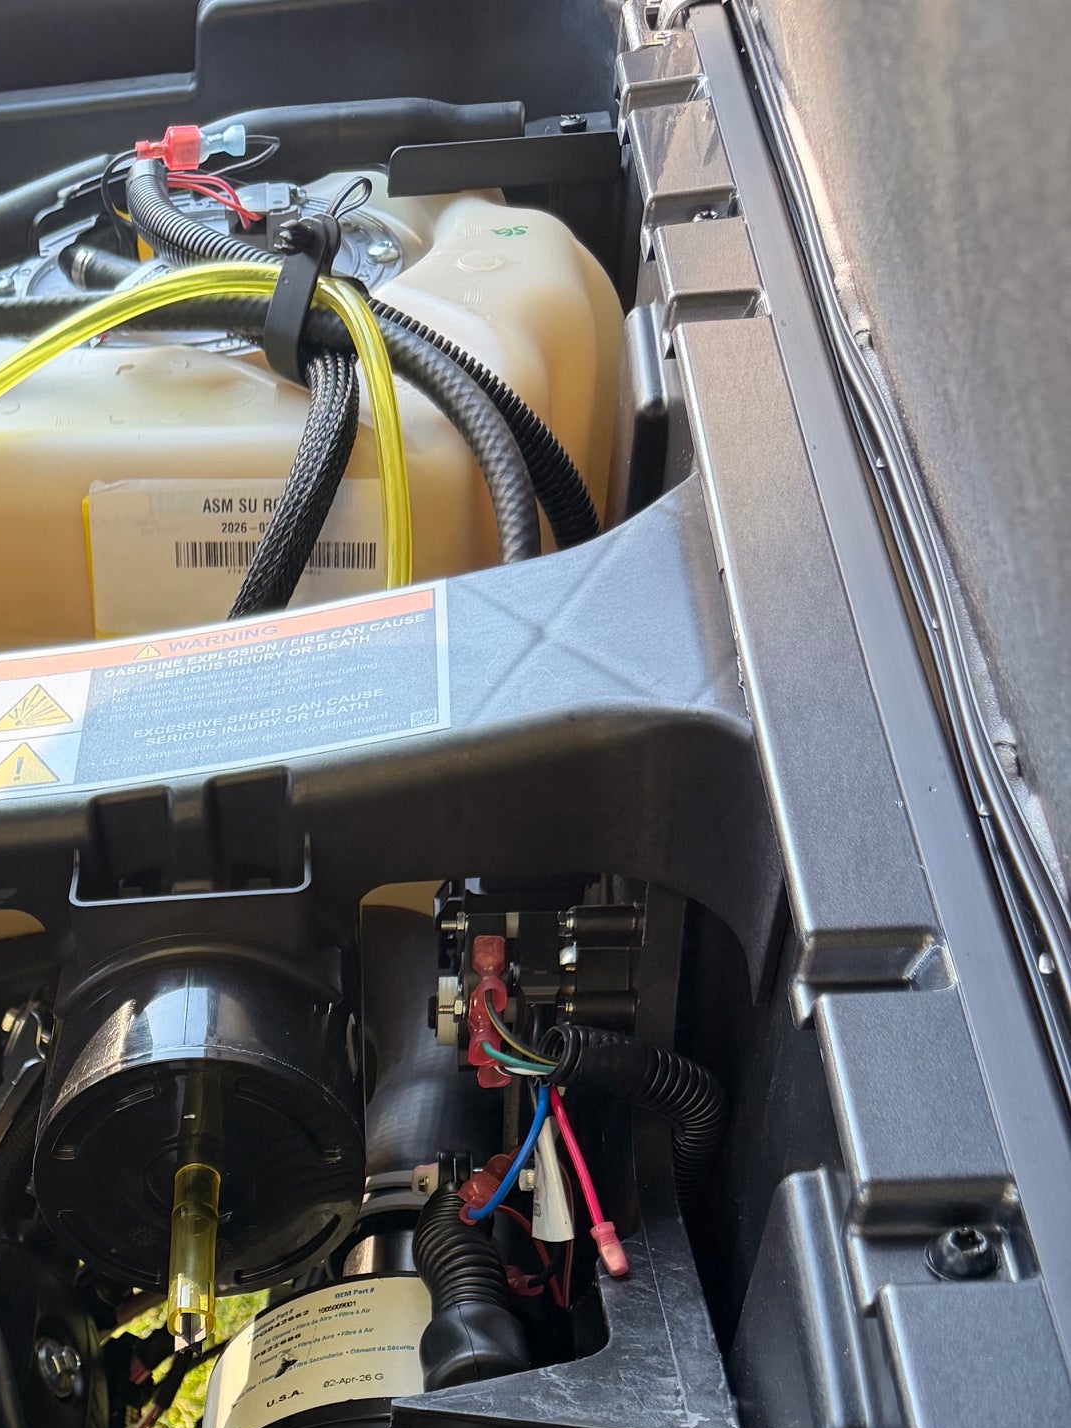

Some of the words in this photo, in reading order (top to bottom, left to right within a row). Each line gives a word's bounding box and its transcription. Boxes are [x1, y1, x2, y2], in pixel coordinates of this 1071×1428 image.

[203, 498, 232, 513] ASM
[239, 498, 257, 513] SU
[104, 658, 182, 677] GASOLINE
[187, 642, 276, 665] EXPLOSION
[281, 640, 286, 648] /
[290, 632, 325, 647] FIRE
[330, 625, 364, 638] CAN
[369, 613, 424, 631] CAUSE
[168, 625, 277, 652] WARNING
[154, 661, 222, 679] SERIOUS
[227, 650, 284, 667] INJURY
[288, 644, 312, 656] OR
[317, 634, 370, 651] DEATH
[133, 717, 222, 738] EXCESSIVE
[227, 707, 282, 723] SPEED
[286, 700, 321, 713] CAN
[326, 687, 383, 705] CAUSE
[145, 727, 216, 746] SERIOUS
[221, 717, 280, 734] INJURY
[284, 712, 309, 723] OR
[314, 700, 368, 718] DEATH
[335, 1291, 351, 1299] OEM
[323, 1374, 372, 1388] 02-Apr-26
[266, 1390, 304, 1407] U.S.A.
